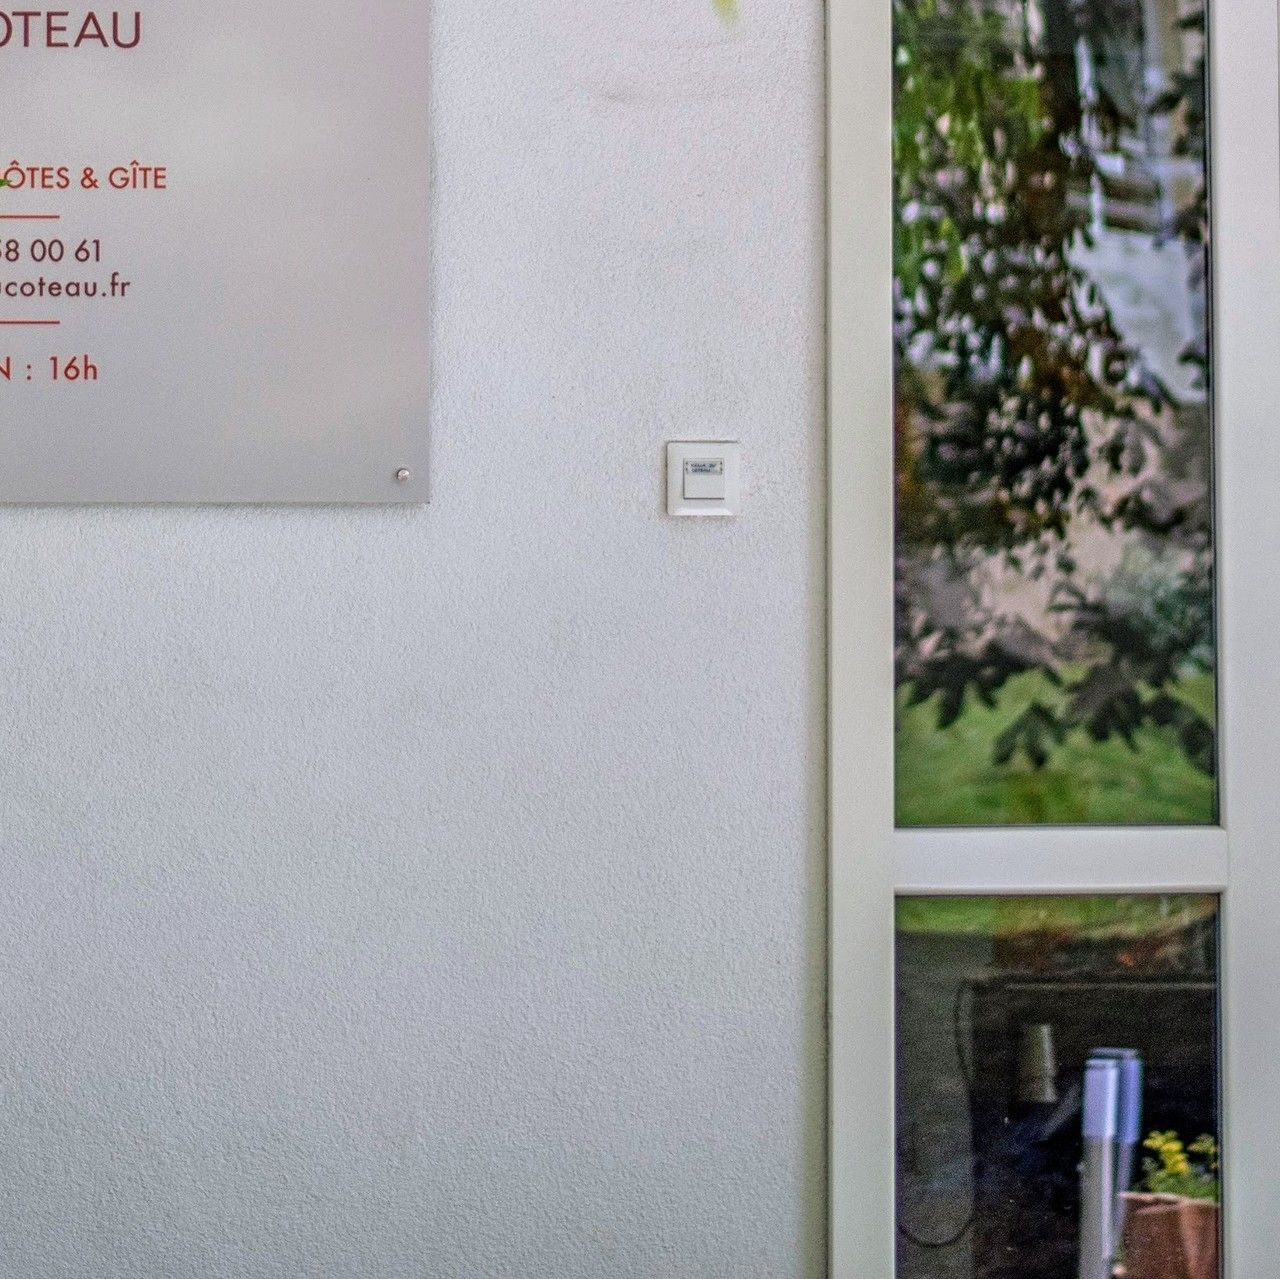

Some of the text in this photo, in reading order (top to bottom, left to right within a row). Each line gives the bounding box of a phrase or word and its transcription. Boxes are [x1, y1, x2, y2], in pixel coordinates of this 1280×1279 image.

[80, 166, 99, 189] &
[108, 160, 167, 189] GÎTE
[30, 238, 65, 262] 00
[74, 238, 101, 262] 61
[48, 354, 98, 380] 16h
